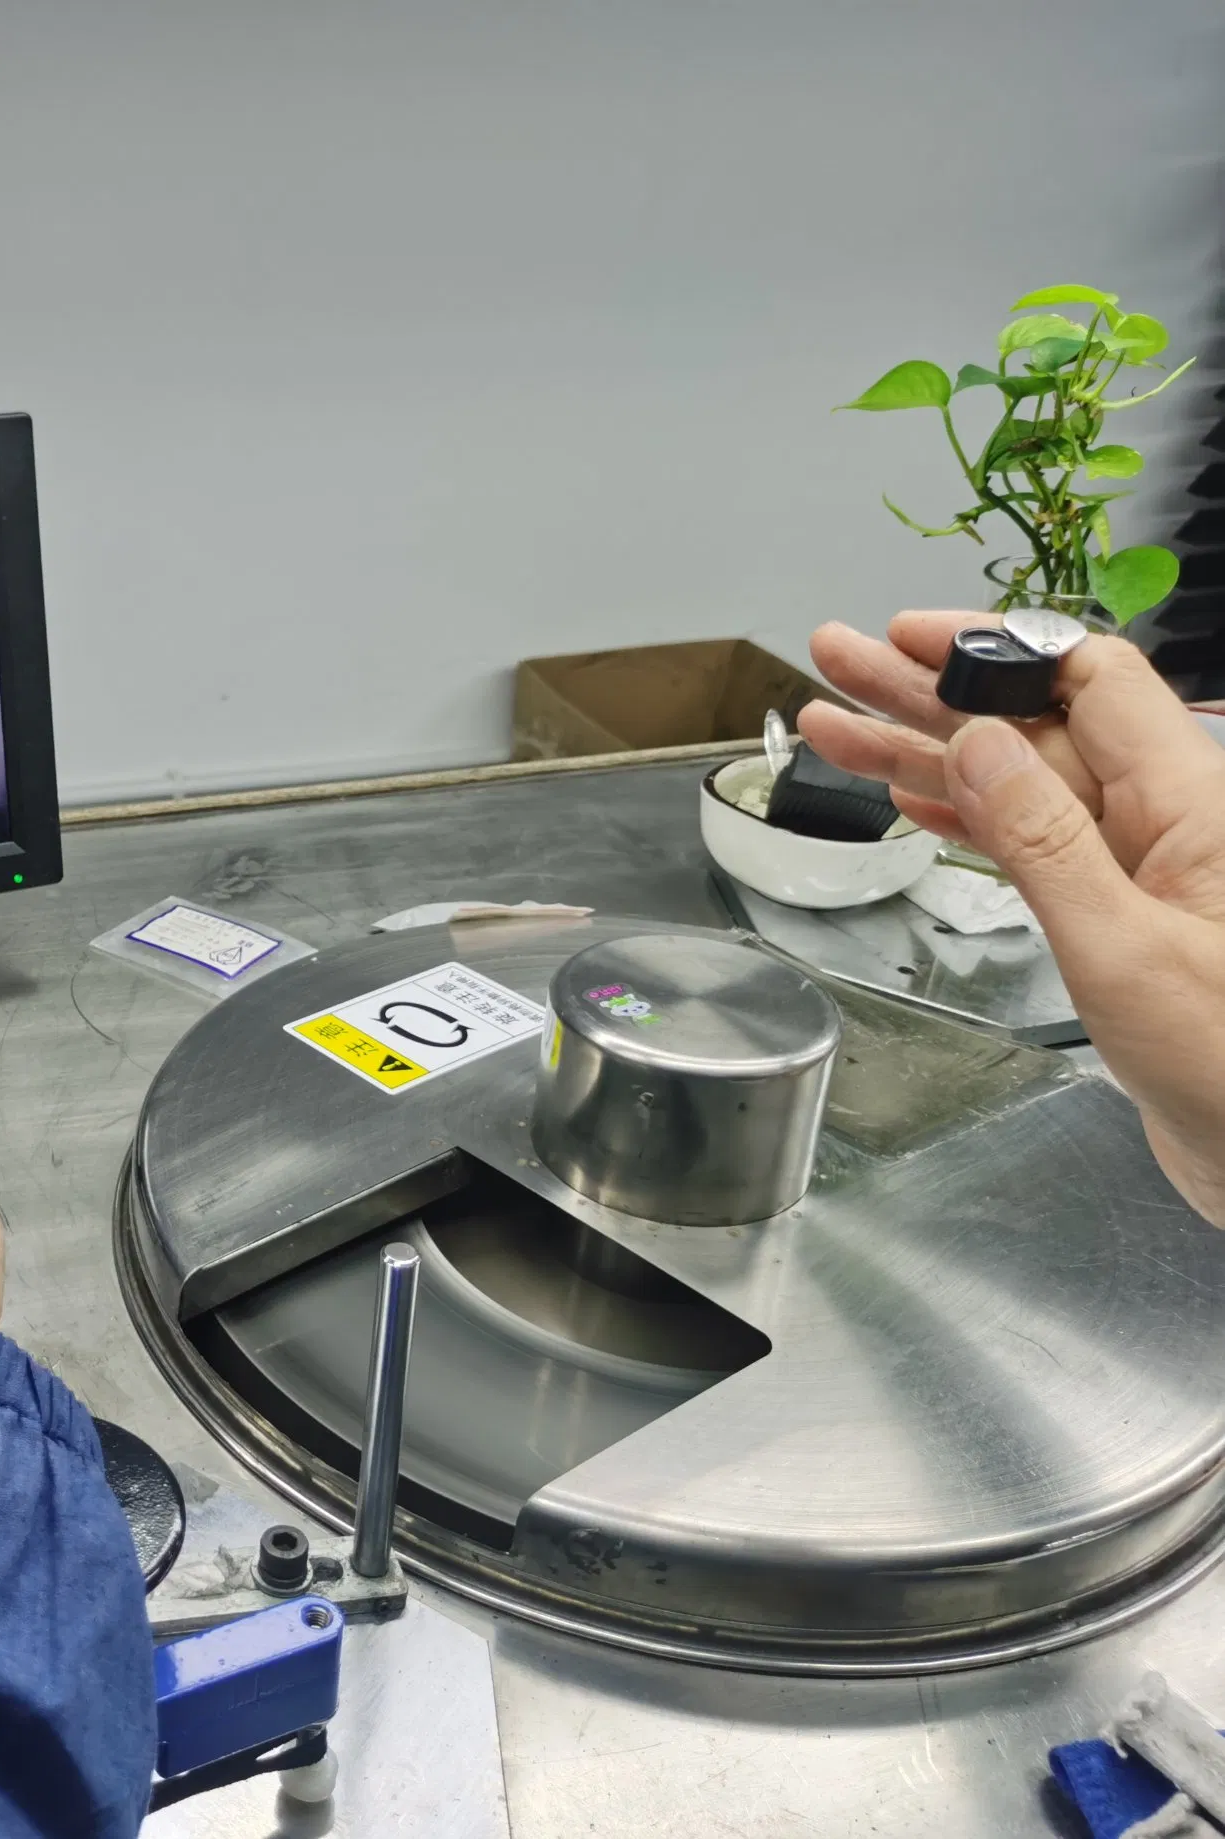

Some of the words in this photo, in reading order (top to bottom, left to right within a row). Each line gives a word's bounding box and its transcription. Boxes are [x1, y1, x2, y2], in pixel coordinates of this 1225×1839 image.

[435, 979, 520, 1027] 旋转注意
[313, 1020, 380, 1058] 注意
